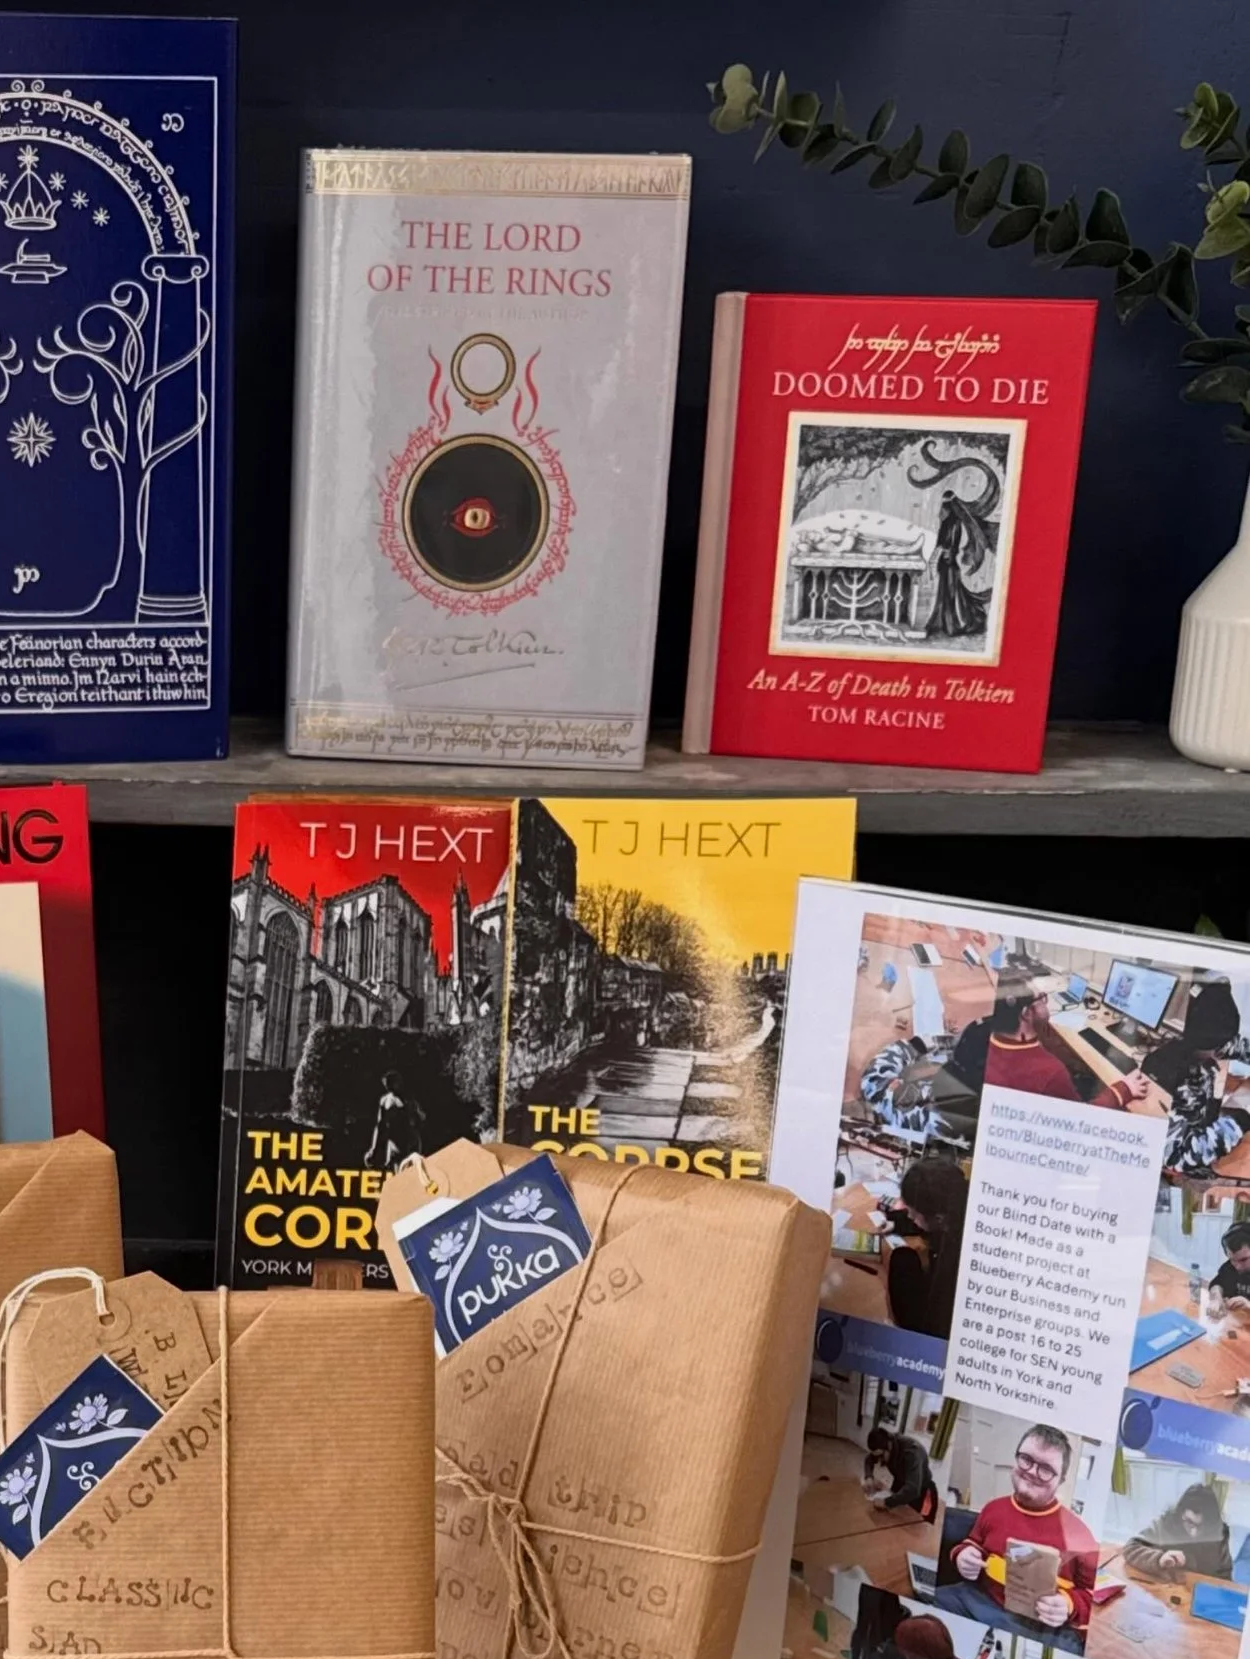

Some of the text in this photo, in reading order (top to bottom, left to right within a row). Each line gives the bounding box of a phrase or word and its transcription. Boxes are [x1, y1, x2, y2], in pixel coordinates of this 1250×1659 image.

[401, 220, 582, 252] THE LORD
[367, 264, 612, 298] OF THE RINGS
[772, 371, 1050, 405] DOOMED TO DIE
[86, 631, 156, 650] characters
[159, 630, 207, 650] accord-
[747, 667, 1017, 705] An A-Z of Death in Tolkien
[808, 704, 946, 731] TOM RACINE
[300, 822, 494, 864] T J HEXT
[582, 820, 782, 858] T J HEXT
[527, 1105, 603, 1136] THE
[247, 1131, 325, 1162] THE
[244, 1166, 396, 1199] AMATE
[980, 1181, 1119, 1226] Thank you for buying
[243, 1203, 380, 1251] COR
[977, 1205, 1117, 1244] our Blind Date with a
[241, 1259, 292, 1275] YORK
[458, 1245, 561, 1324] pukka
[955, 1372, 1056, 1409] North Yorkshire.
